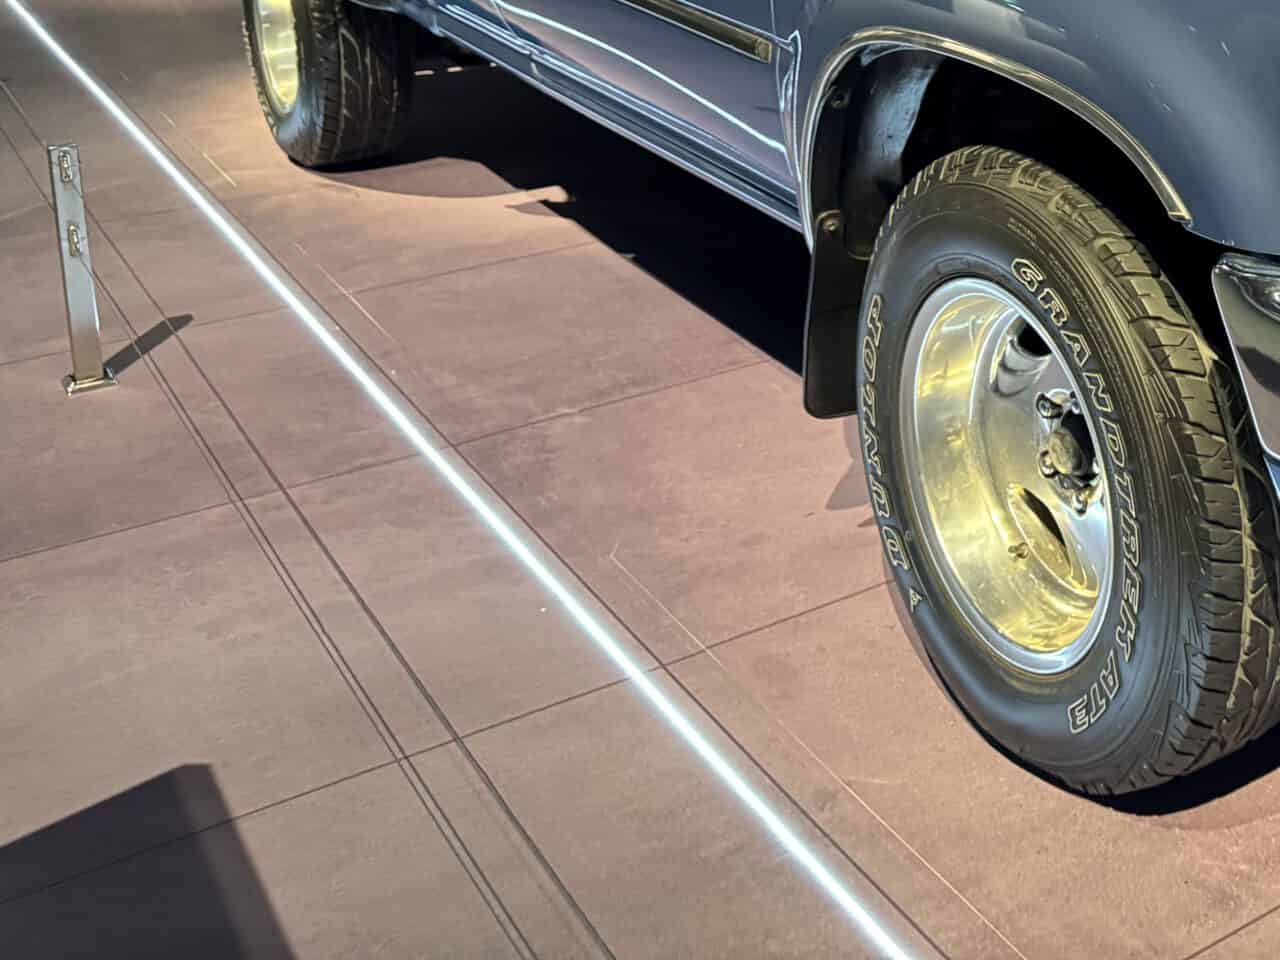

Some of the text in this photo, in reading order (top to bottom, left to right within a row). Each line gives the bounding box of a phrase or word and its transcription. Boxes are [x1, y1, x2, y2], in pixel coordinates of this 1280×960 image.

[859, 294, 909, 571] DUNLOP
[1011, 257, 1144, 735] GRANDTREK AT3
